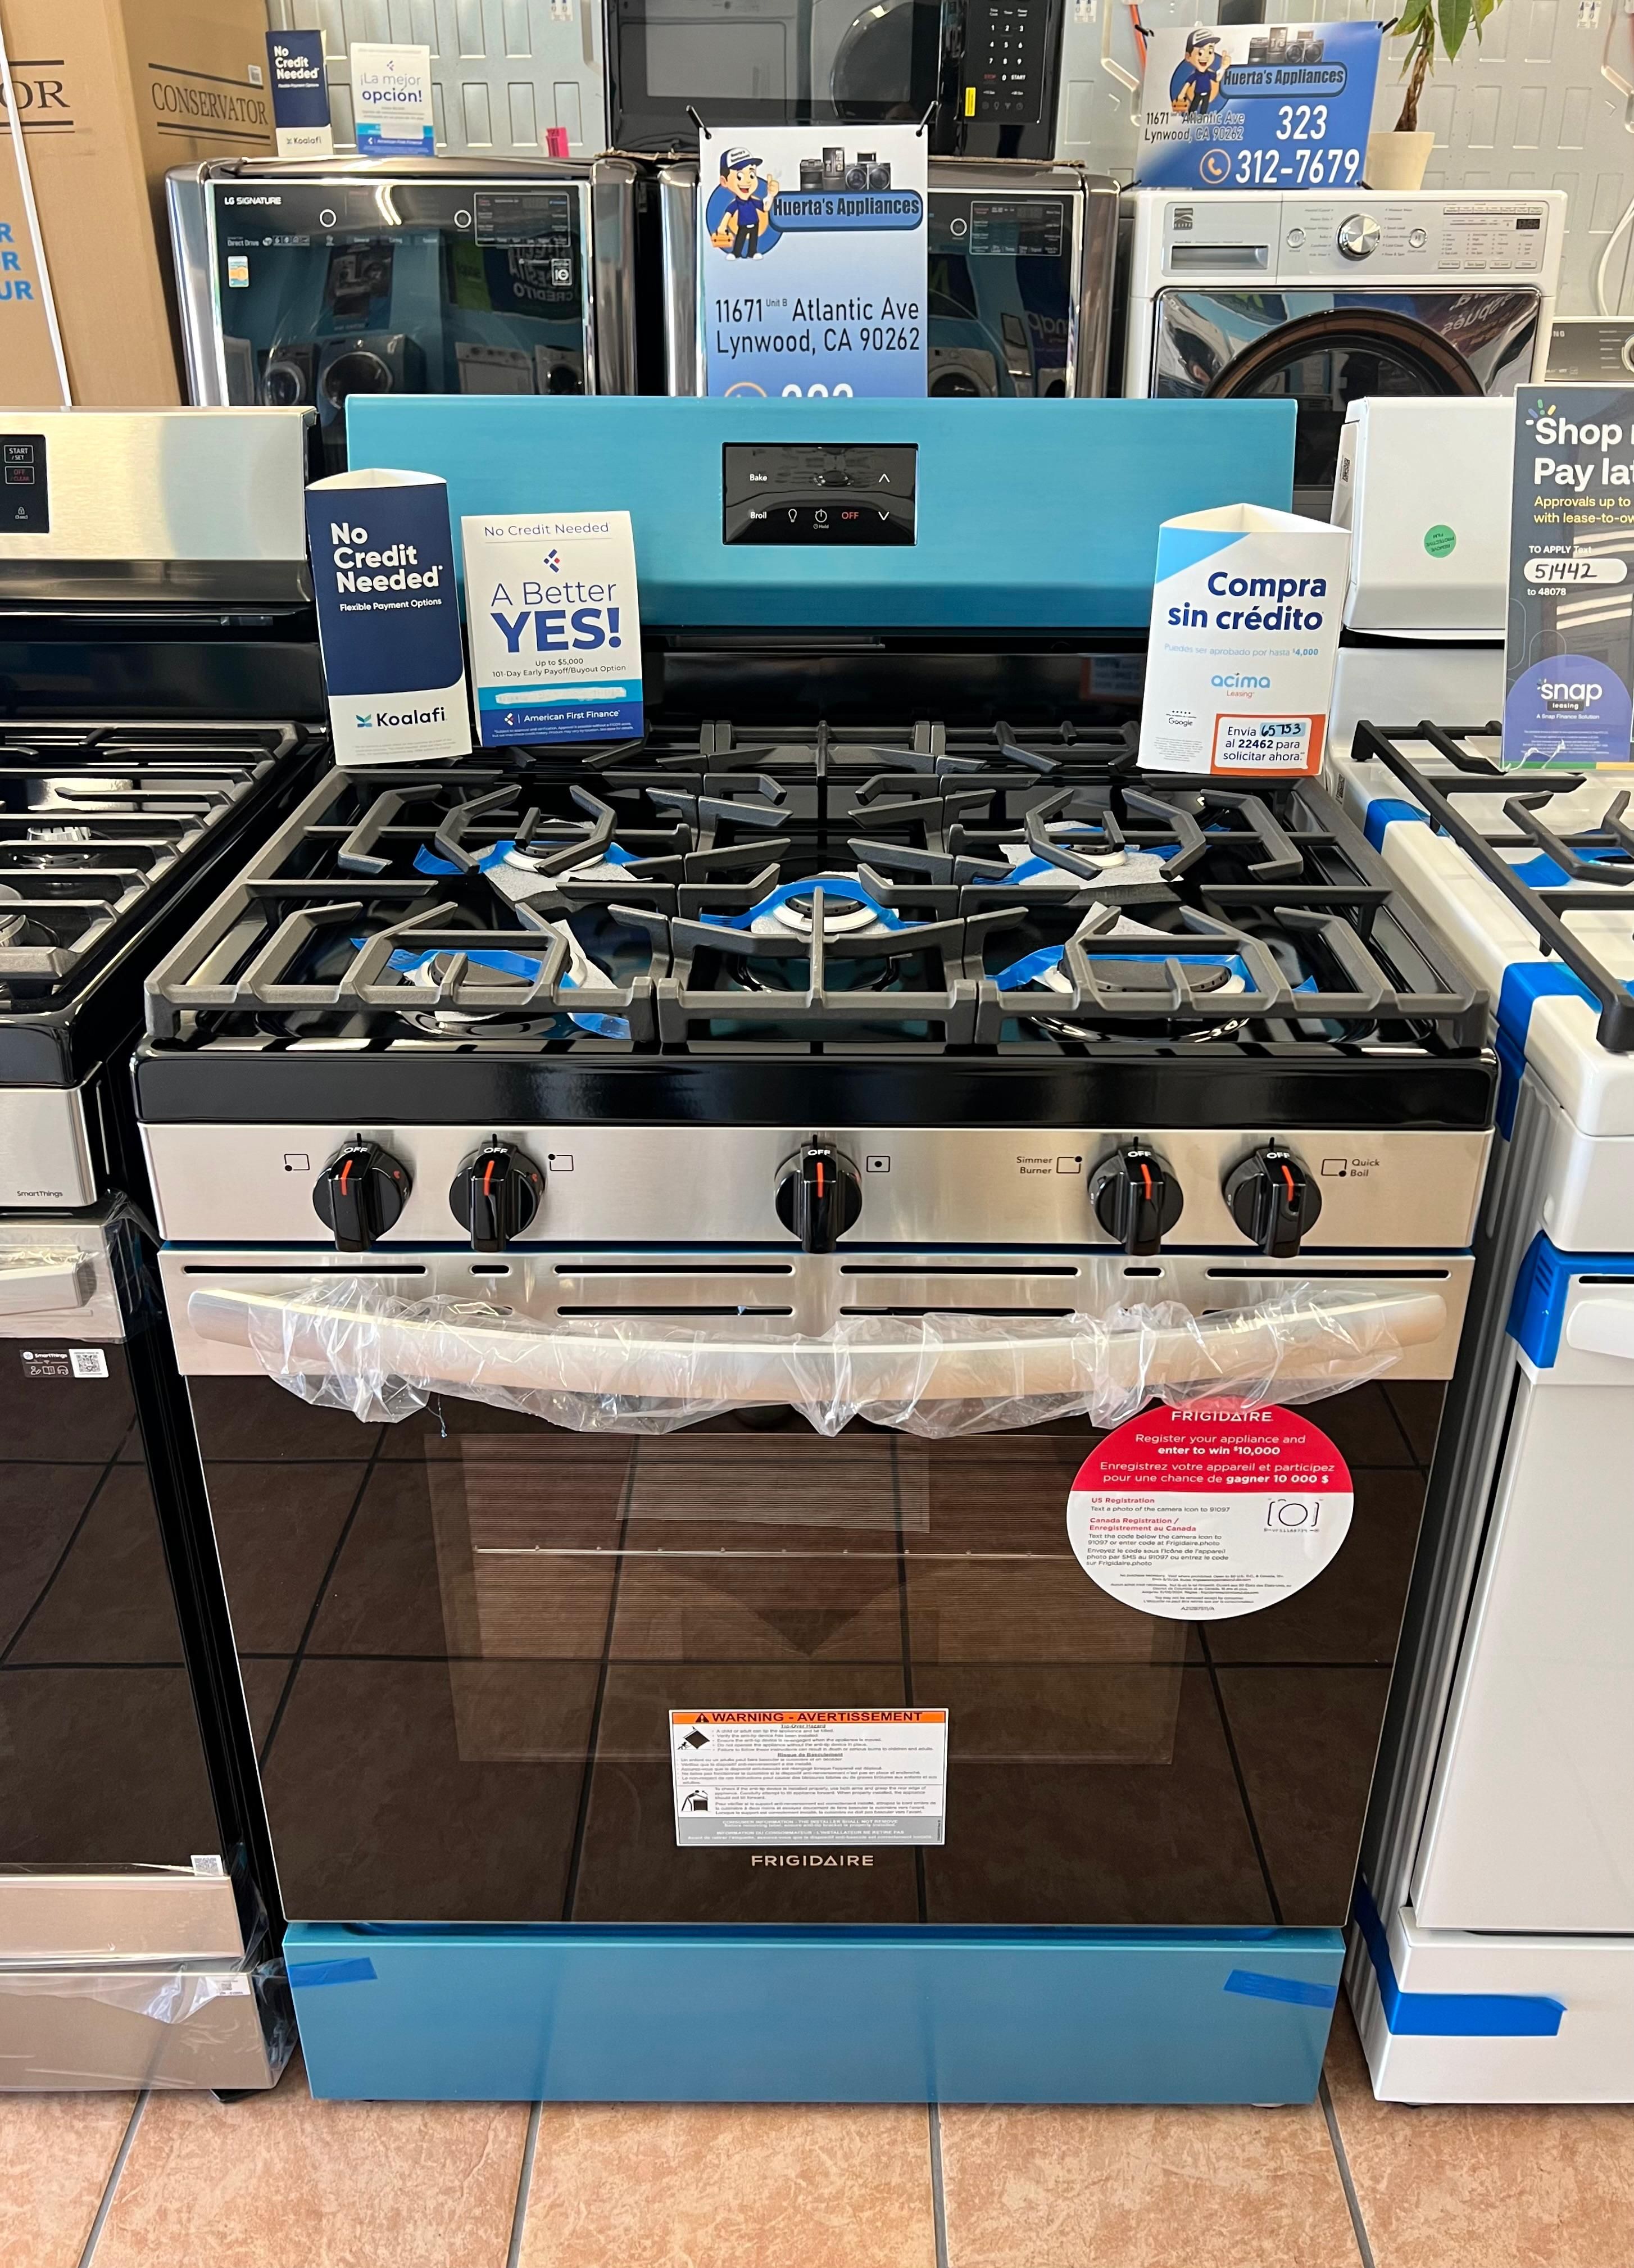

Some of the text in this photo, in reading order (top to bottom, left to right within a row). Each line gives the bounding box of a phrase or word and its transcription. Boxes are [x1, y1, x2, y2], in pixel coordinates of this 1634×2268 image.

[274, 46, 289, 56] No
[275, 57, 308, 68] Credit
[361, 73, 421, 90] ¡La mejor
[1224, 69, 1343, 86] Huerta's Appliances
[362, 88, 423, 103] opción!
[151, 83, 269, 125] CONSERVATOR
[1146, 111, 1245, 125] 11671 Atlantic Ave
[1276, 105, 1327, 140] 323
[1145, 126, 1243, 144] Lynwood, CA 90262
[1236, 148, 1360, 184] 312-7679
[773, 197, 919, 217] Huerta's Appliances
[716, 297, 919, 323] 11671 Unit B Atlantic Ave
[716, 327, 920, 360] Lynwood, CA 90262
[1535, 417, 1623, 452] Shop
[1534, 457, 1594, 492] Pay
[1534, 496, 1631, 509] Approvals up to
[1534, 513, 1560, 523] with
[330, 523, 368, 545] No
[484, 522, 609, 537] No Credit Needed
[334, 544, 417, 569] Credit
[1535, 563, 1597, 581] 51442
[1208, 571, 1327, 603] Compra
[1538, 588, 1567, 596] 48078
[491, 582, 616, 607] A Better
[339, 598, 442, 611] Flexible Payment Options
[1168, 602, 1323, 630] sin crédito
[490, 607, 621, 653] YES!
[1165, 643, 1193, 654] Puedes
[1209, 647, 1251, 656] aprobado
[1270, 648, 1290, 656] hasta
[1292, 648, 1318, 657] $4,000
[558, 657, 584, 666] $5,000
[492, 670, 521, 678] 101-Day
[544, 665, 598, 675] Payoff/Buyout
[1227, 690, 1253, 699] Leasing
[1541, 683, 1603, 706] snap
[376, 706, 445, 727] Koalafi
[524, 710, 619, 723] American First Finance
[1168, 717, 1193, 727] Google
[1228, 723, 1301, 737] Envía 65753
[1226, 739, 1300, 750] al 22462 para
[1223, 752, 1266, 761] solicitar
[1352, 1158, 1379, 1168] Quick
[1172, 1411, 1272, 1422] FRIGIDAIRE
[1136, 1434, 1186, 1444] Register
[1220, 1435, 1279, 1444] appliance
[1233, 1446, 1280, 1456] $10,000
[1100, 1462, 1168, 1472] Enregistrez
[1206, 1463, 1255, 1472] appareil
[1274, 1463, 1335, 1472] participez
[1103, 1475, 1131, 1483] pour
[1160, 1474, 1204, 1482] chance
[1207, 1475, 1223, 1483] de
[1226, 1475, 1270, 1484] gagner
[1274, 1475, 1287, 1483] 10
[1321, 1475, 1329, 1484] $
[712, 1712, 923, 1722] WARNING AVERTISSEMENT
[751, 1856, 874, 1866] FRIGIDAIRE
